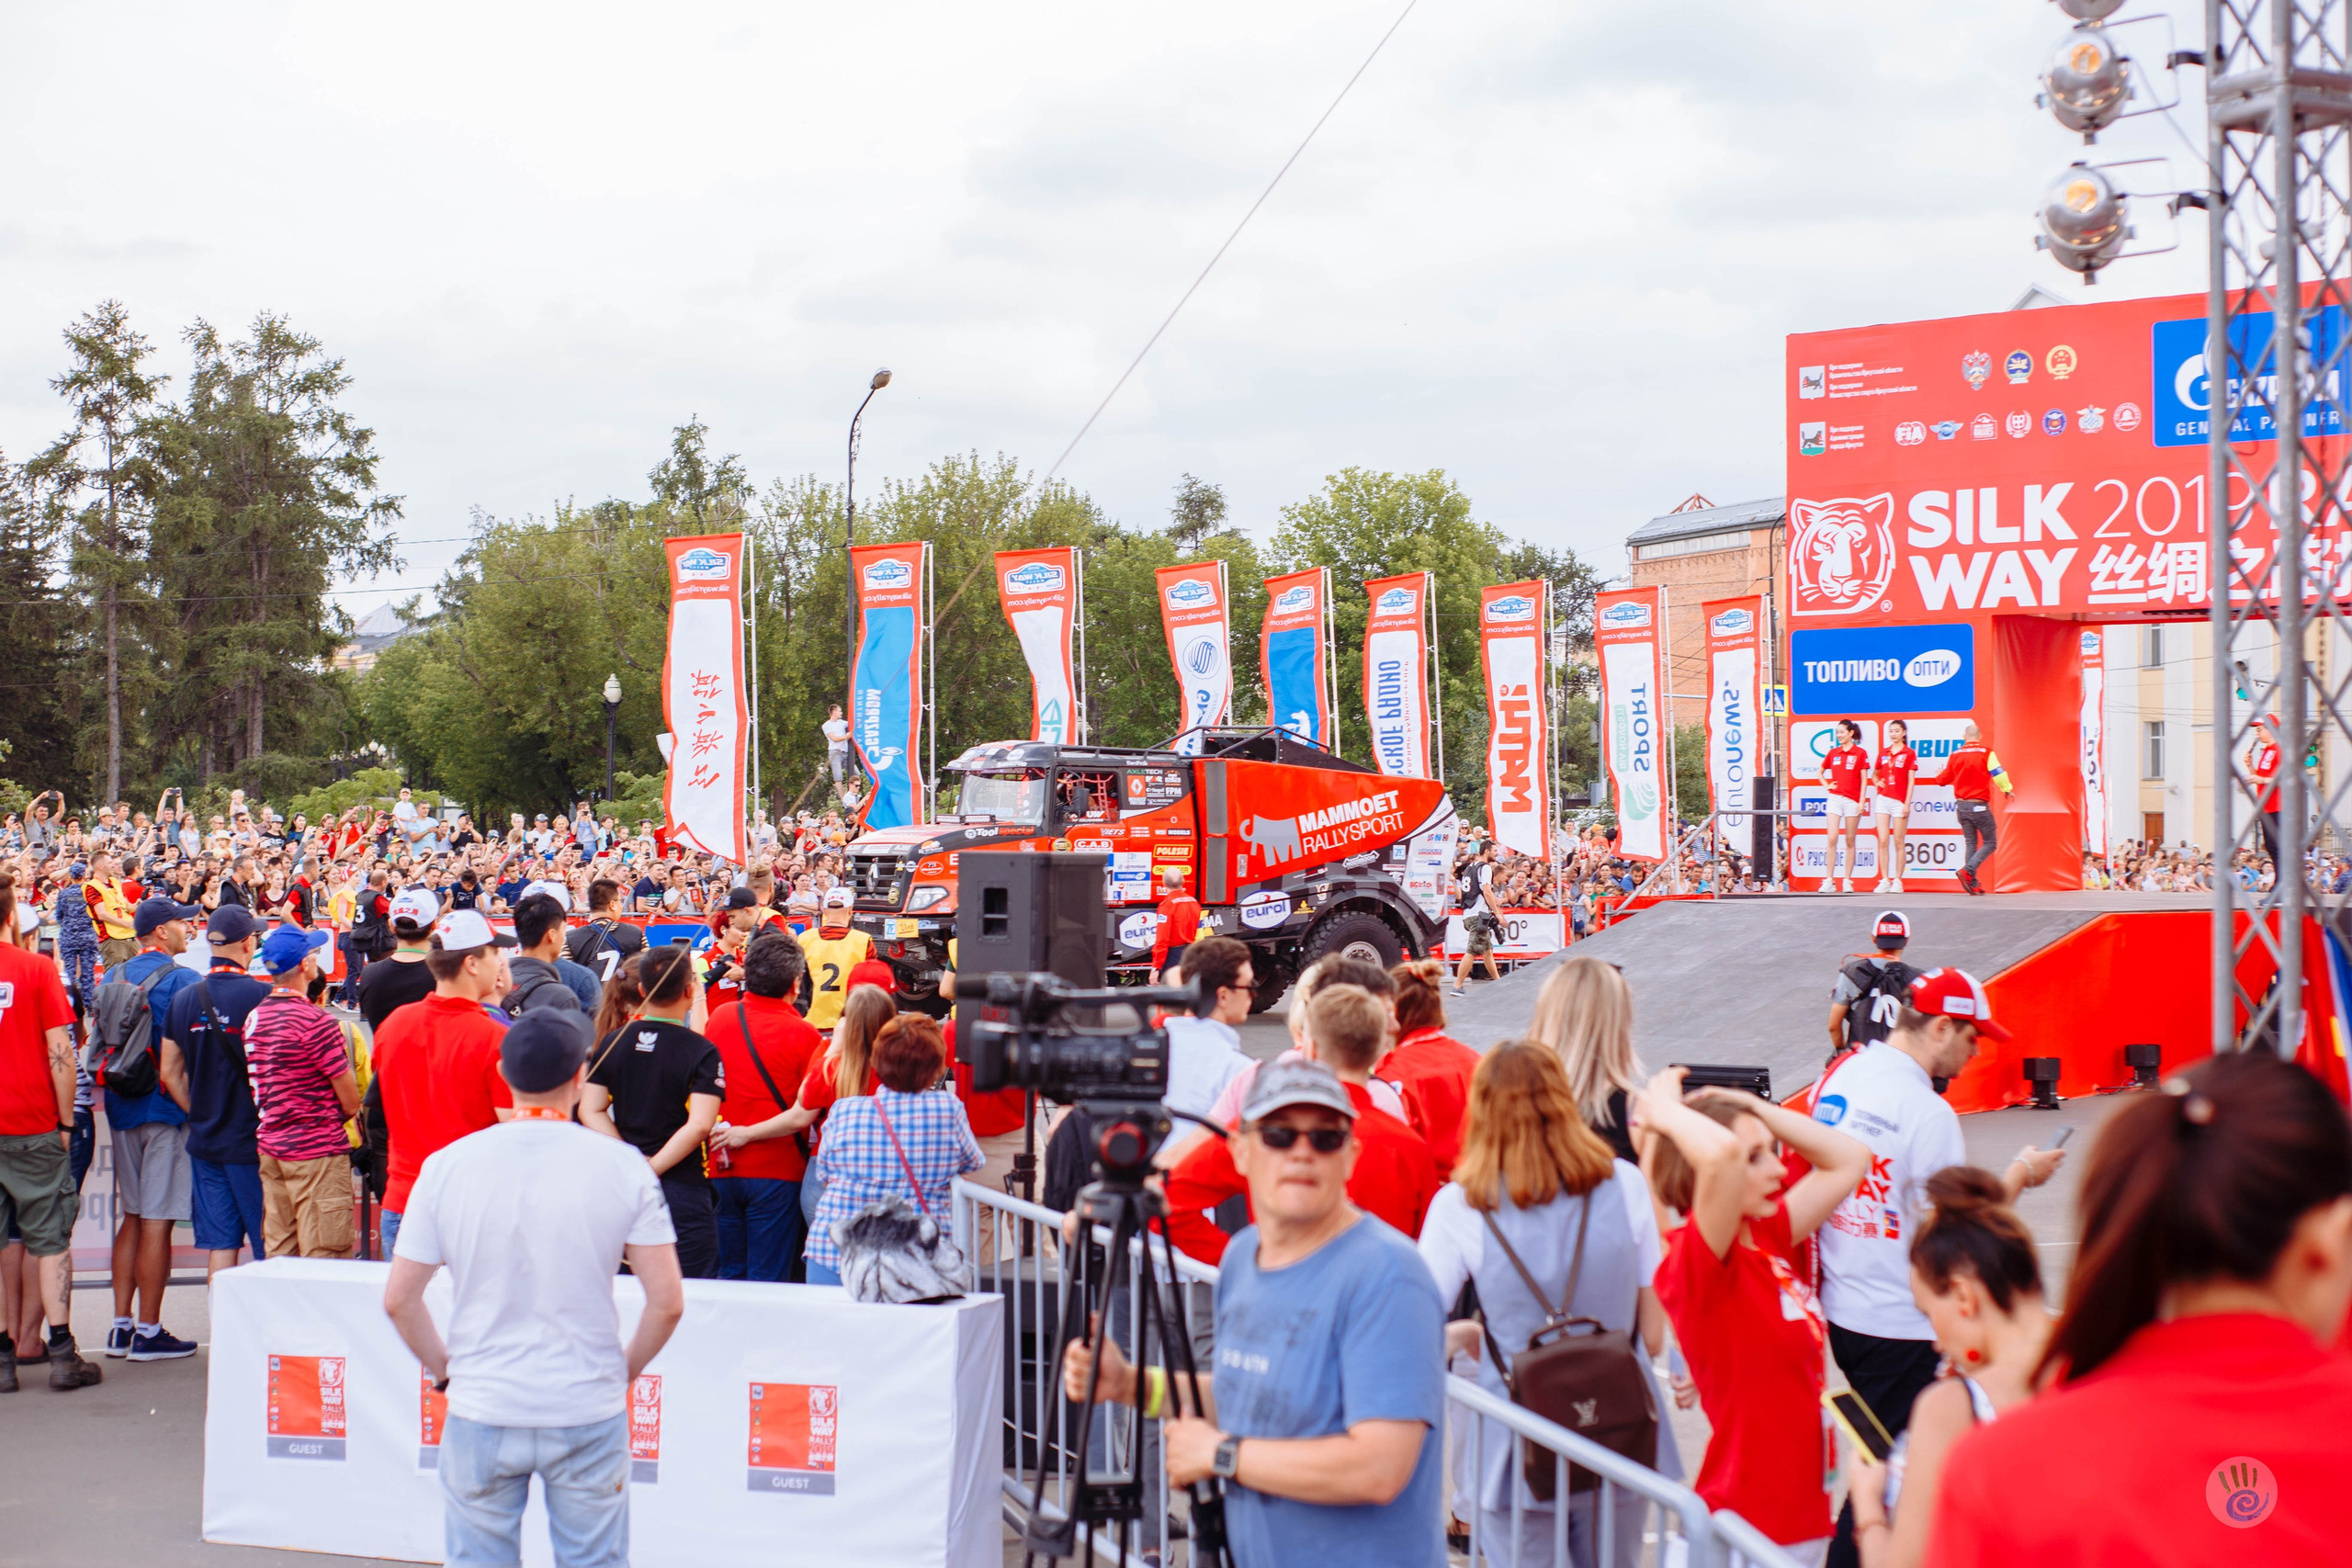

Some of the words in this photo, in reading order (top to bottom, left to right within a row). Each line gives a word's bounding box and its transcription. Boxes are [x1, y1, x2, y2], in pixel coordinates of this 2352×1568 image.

[2175, 418, 2252, 436] GENAL
[2260, 411, 2340, 430] PANER
[1907, 481, 2079, 548] SILK
[2093, 471, 2255, 539] 2019
[1908, 547, 2079, 611] WAY
[1803, 658, 1901, 683] ТОПЛИВО
[1913, 660, 1950, 677] ОПТИ
[1298, 790, 1399, 834] MAMMOET
[1302, 811, 1405, 855] RALLYSPORT
[1156, 847, 1189, 855] POLESIE
[1904, 842, 1957, 864] 360°
[355, 905, 366, 923] 3
[1246, 901, 1286, 919] eurol
[1125, 926, 1157, 939] euro
[597, 950, 620, 981] 7
[820, 963, 840, 991] 2
[1855, 1178, 1893, 1204] AY
[288, 1443, 323, 1455] GUEST
[772, 1475, 810, 1489] GUEST
